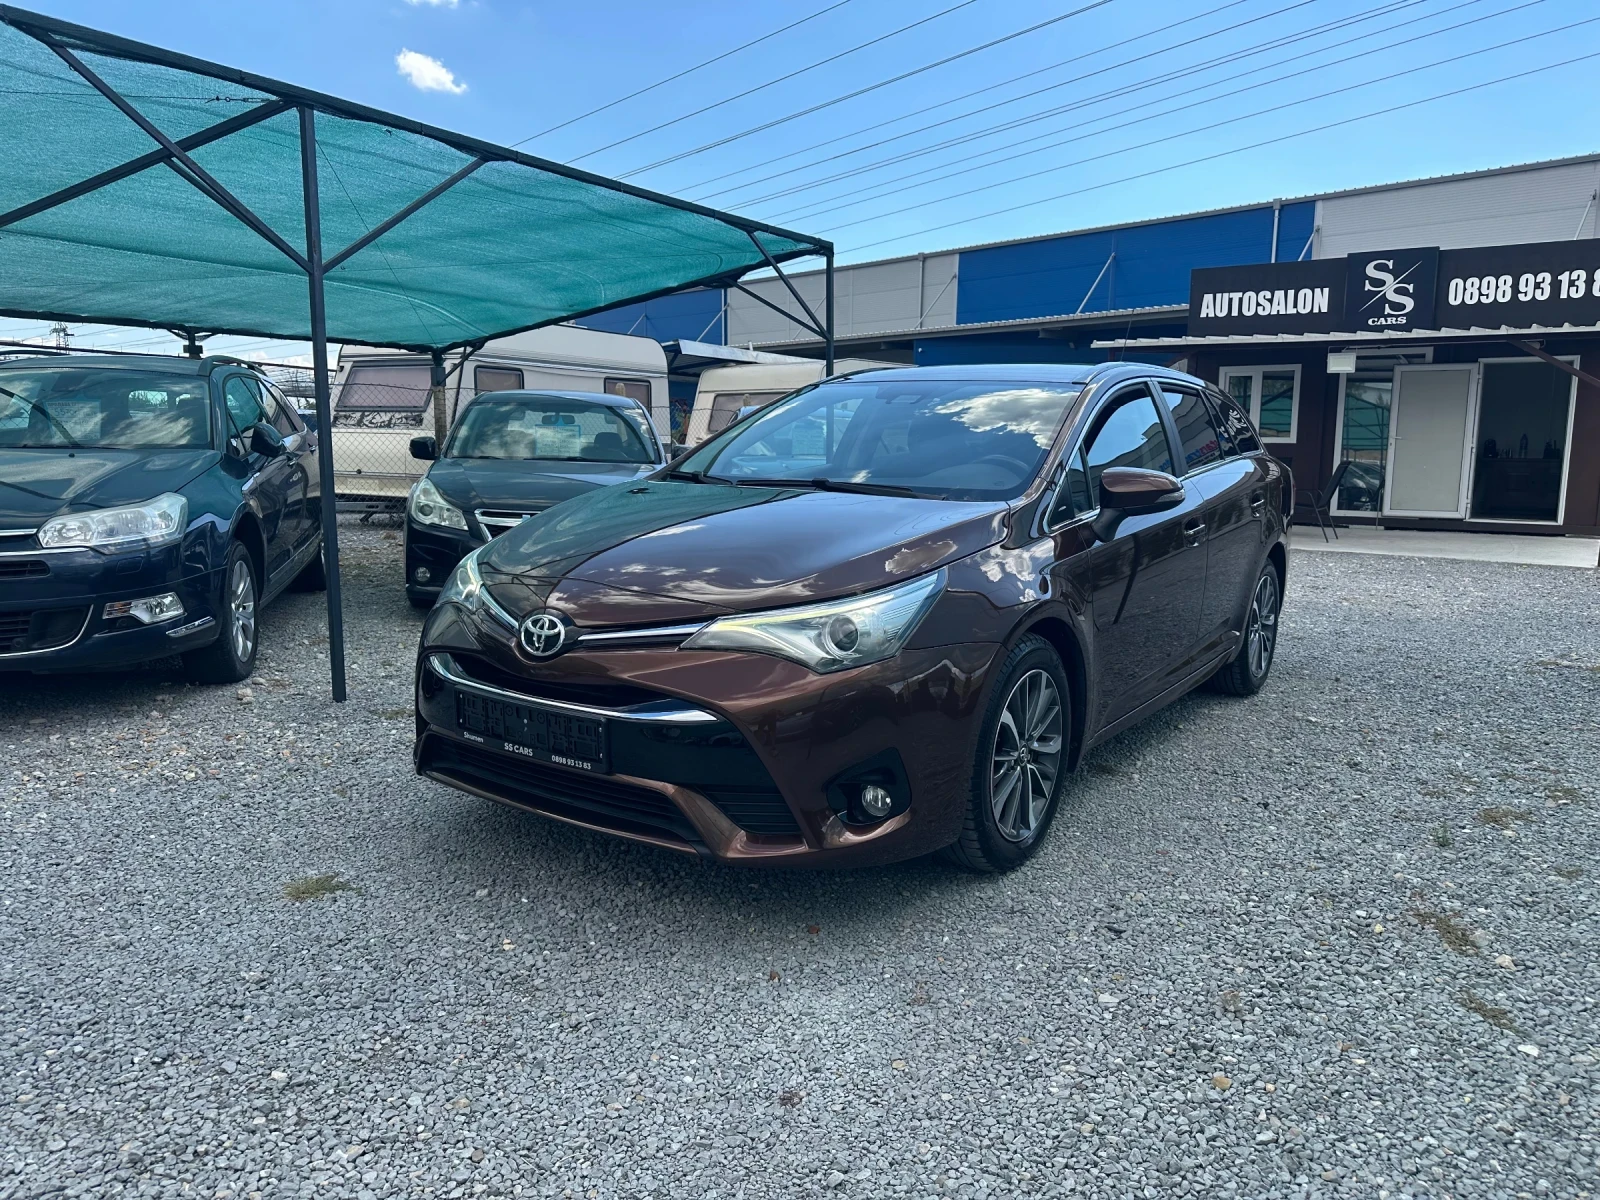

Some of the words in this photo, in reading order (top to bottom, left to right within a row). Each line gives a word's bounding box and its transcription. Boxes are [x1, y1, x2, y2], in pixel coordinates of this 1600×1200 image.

[1200, 287, 1330, 318] AUTOSALON
[1448, 275, 1513, 306] 0898
[1518, 272, 1552, 302] 93
[1558, 269, 1587, 299] 13
[1367, 316, 1407, 326] CARS
[463, 731, 484, 743] Shumen
[504, 742, 513, 752] SS
[514, 744, 534, 757] CARS
[551, 755, 567, 765] 0898
